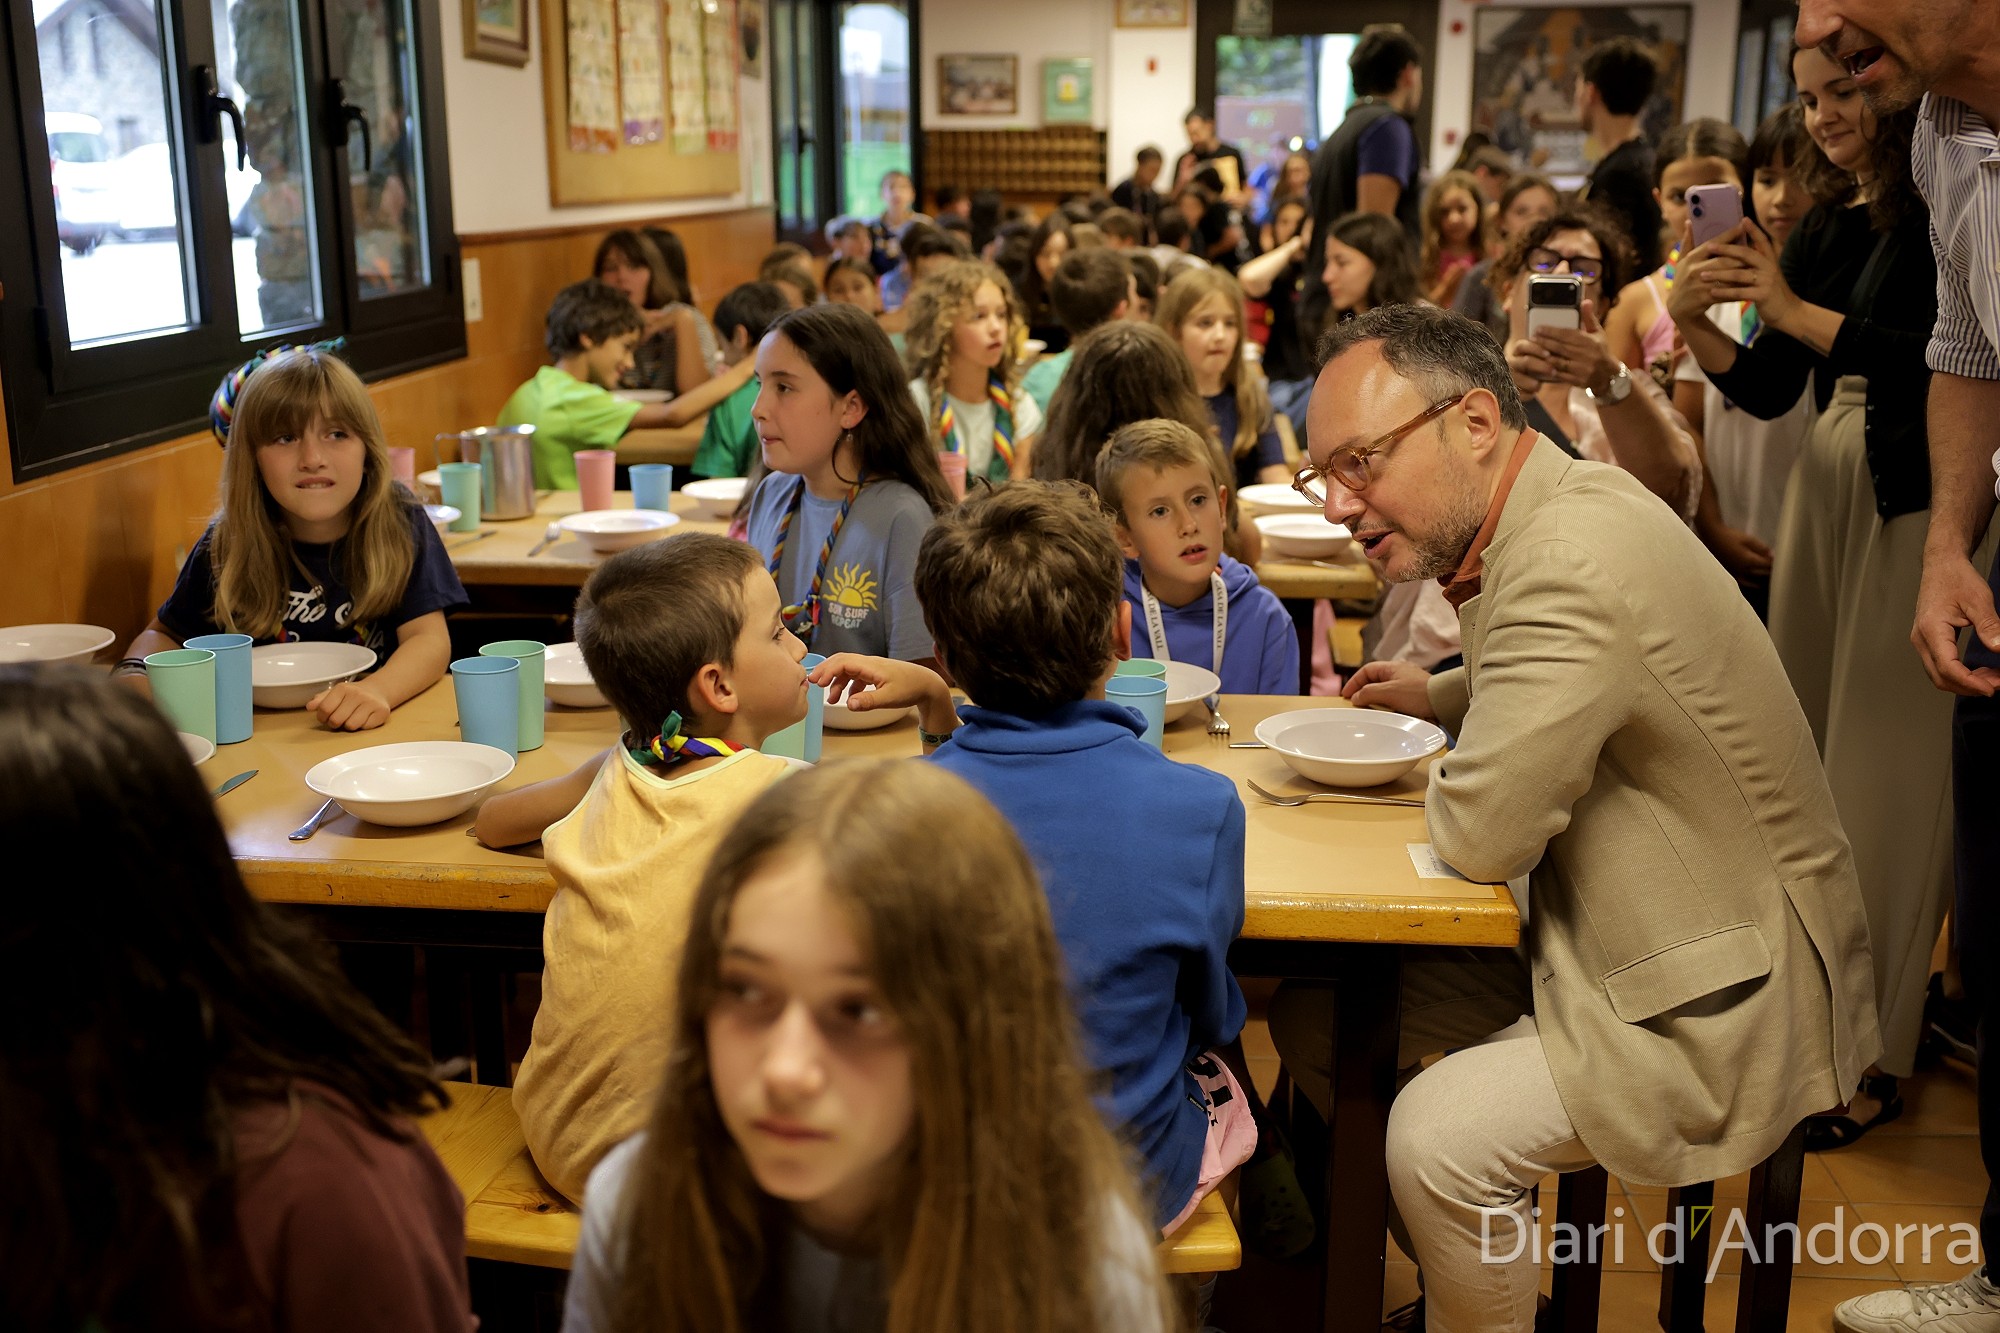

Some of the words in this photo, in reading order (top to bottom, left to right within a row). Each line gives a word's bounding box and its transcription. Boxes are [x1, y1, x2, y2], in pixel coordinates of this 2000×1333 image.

[844, 607, 869, 619] SURF
[831, 615, 862, 629] REPEAT
[1154, 629, 1163, 651] VALL
